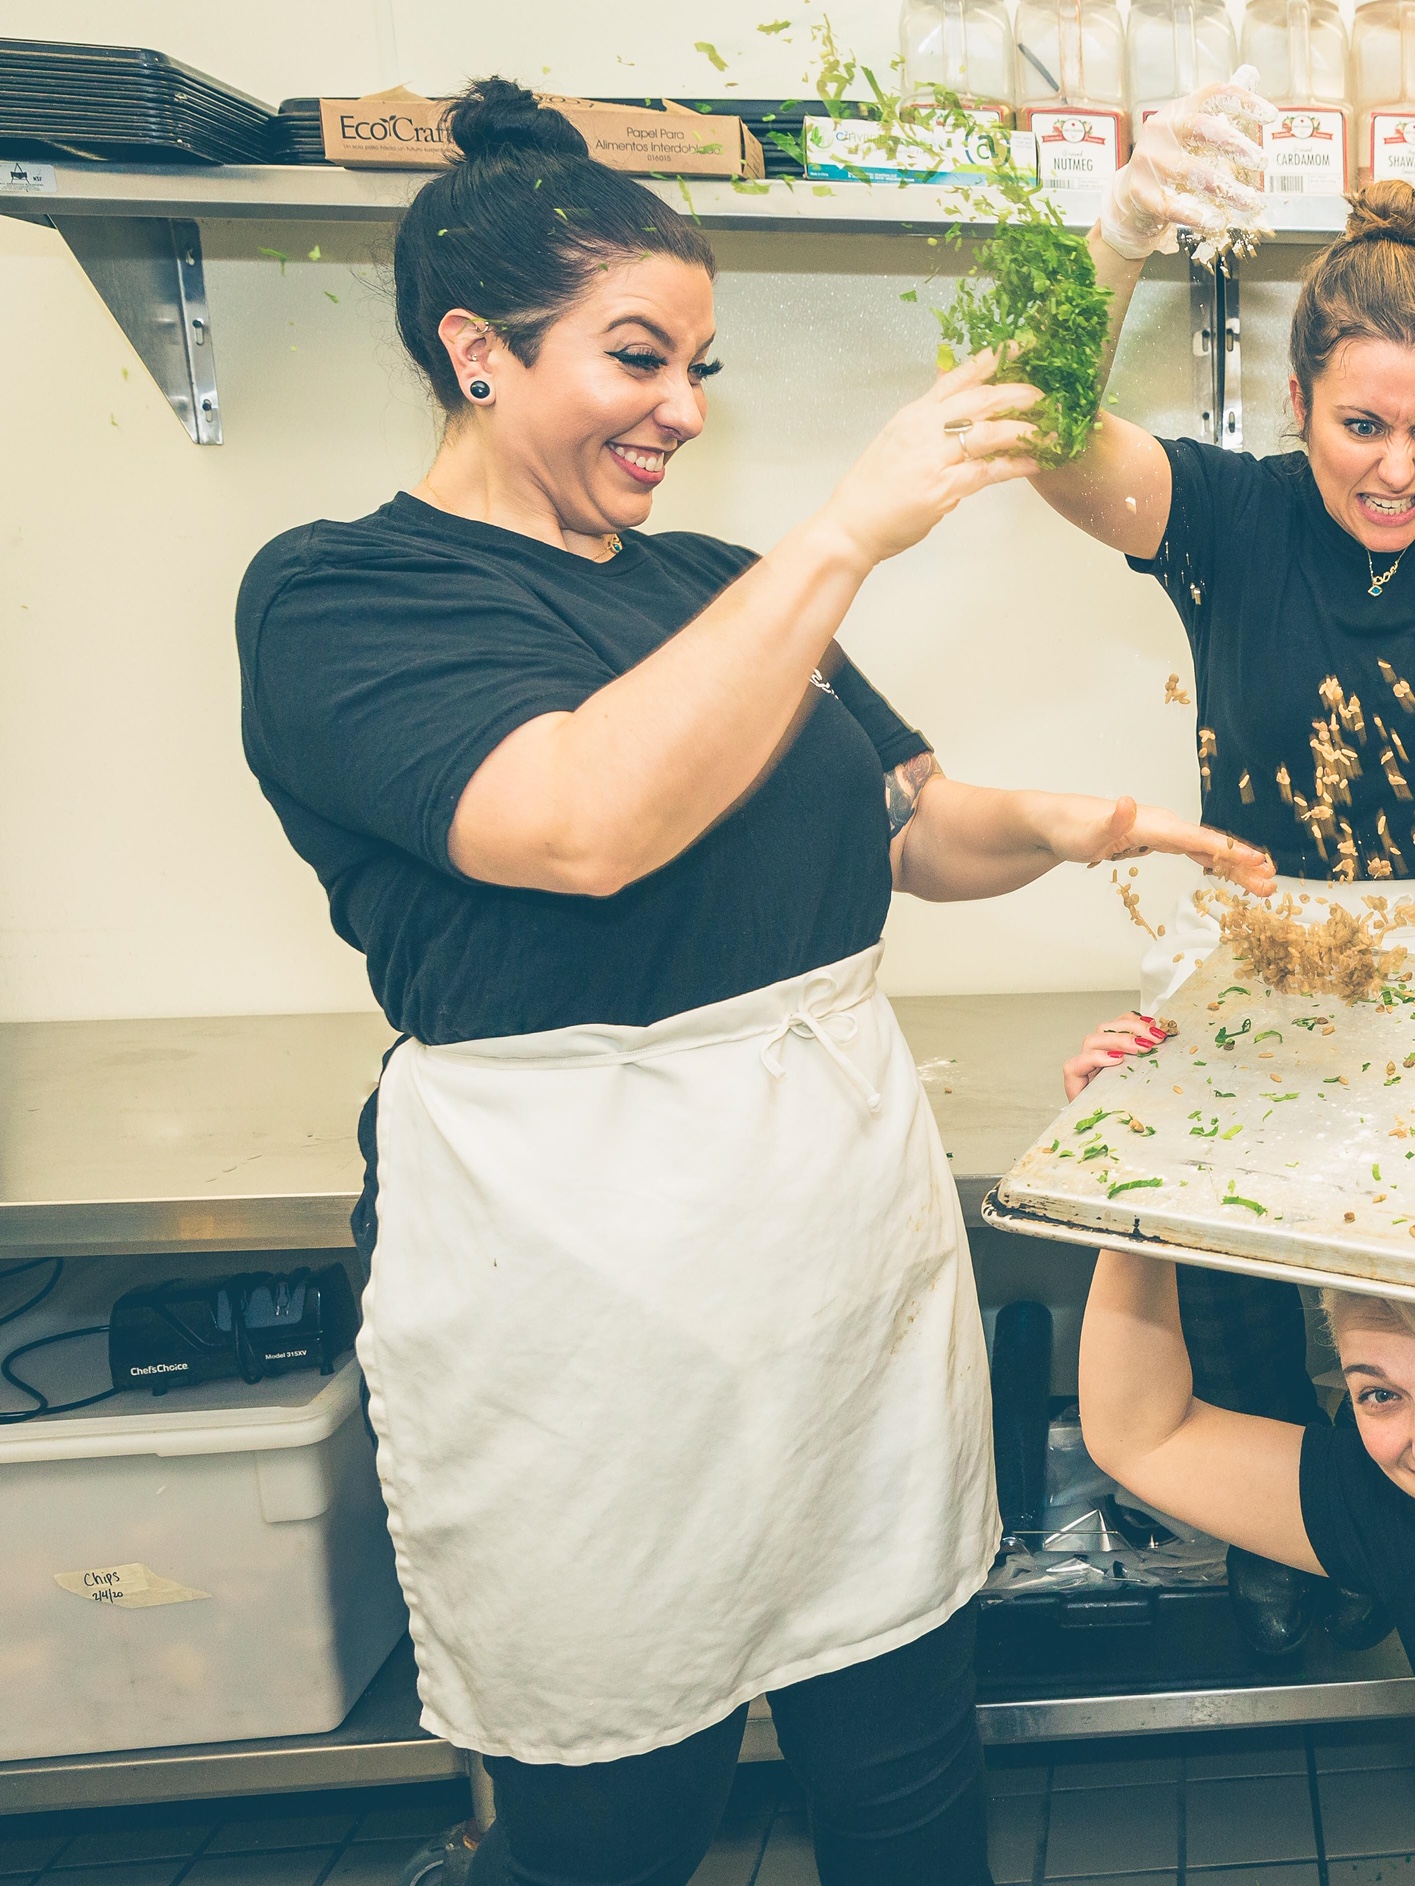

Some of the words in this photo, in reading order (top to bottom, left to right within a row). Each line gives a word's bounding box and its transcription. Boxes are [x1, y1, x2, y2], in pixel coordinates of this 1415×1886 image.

[627, 127, 658, 140] Papel
[660, 129, 685, 140] Para
[595, 139, 649, 152] Alimentos
[647, 154, 672, 162] 016015
[1276, 153, 1331, 167] CARDAMOM
[1053, 158, 1094, 172] NUTMEG
[265, 1352, 286, 1360] Model
[287, 1350, 307, 1358] 315XV
[84, 1571, 120, 1587] Chips
[92, 1588, 124, 1604] 2/4/20
